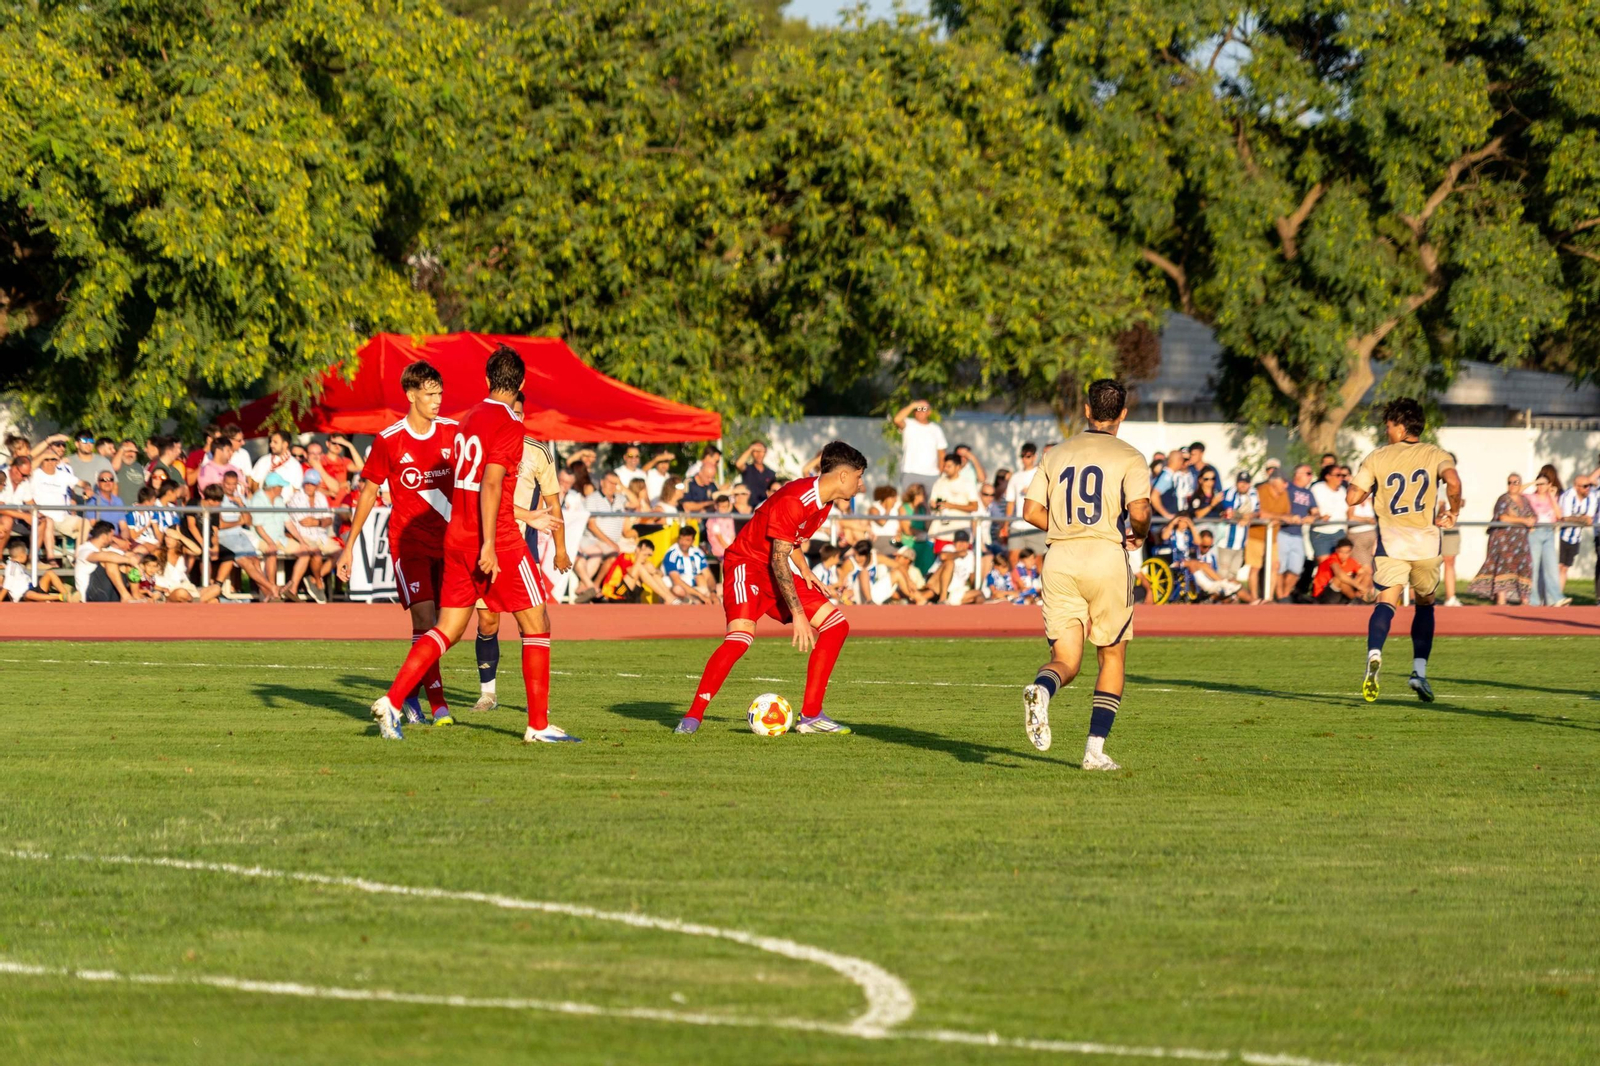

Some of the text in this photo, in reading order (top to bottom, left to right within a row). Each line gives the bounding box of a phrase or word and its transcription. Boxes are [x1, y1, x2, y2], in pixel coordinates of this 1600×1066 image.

[454, 432, 483, 492] 22
[1385, 467, 1430, 516] 22
[1058, 464, 1104, 526] 19
